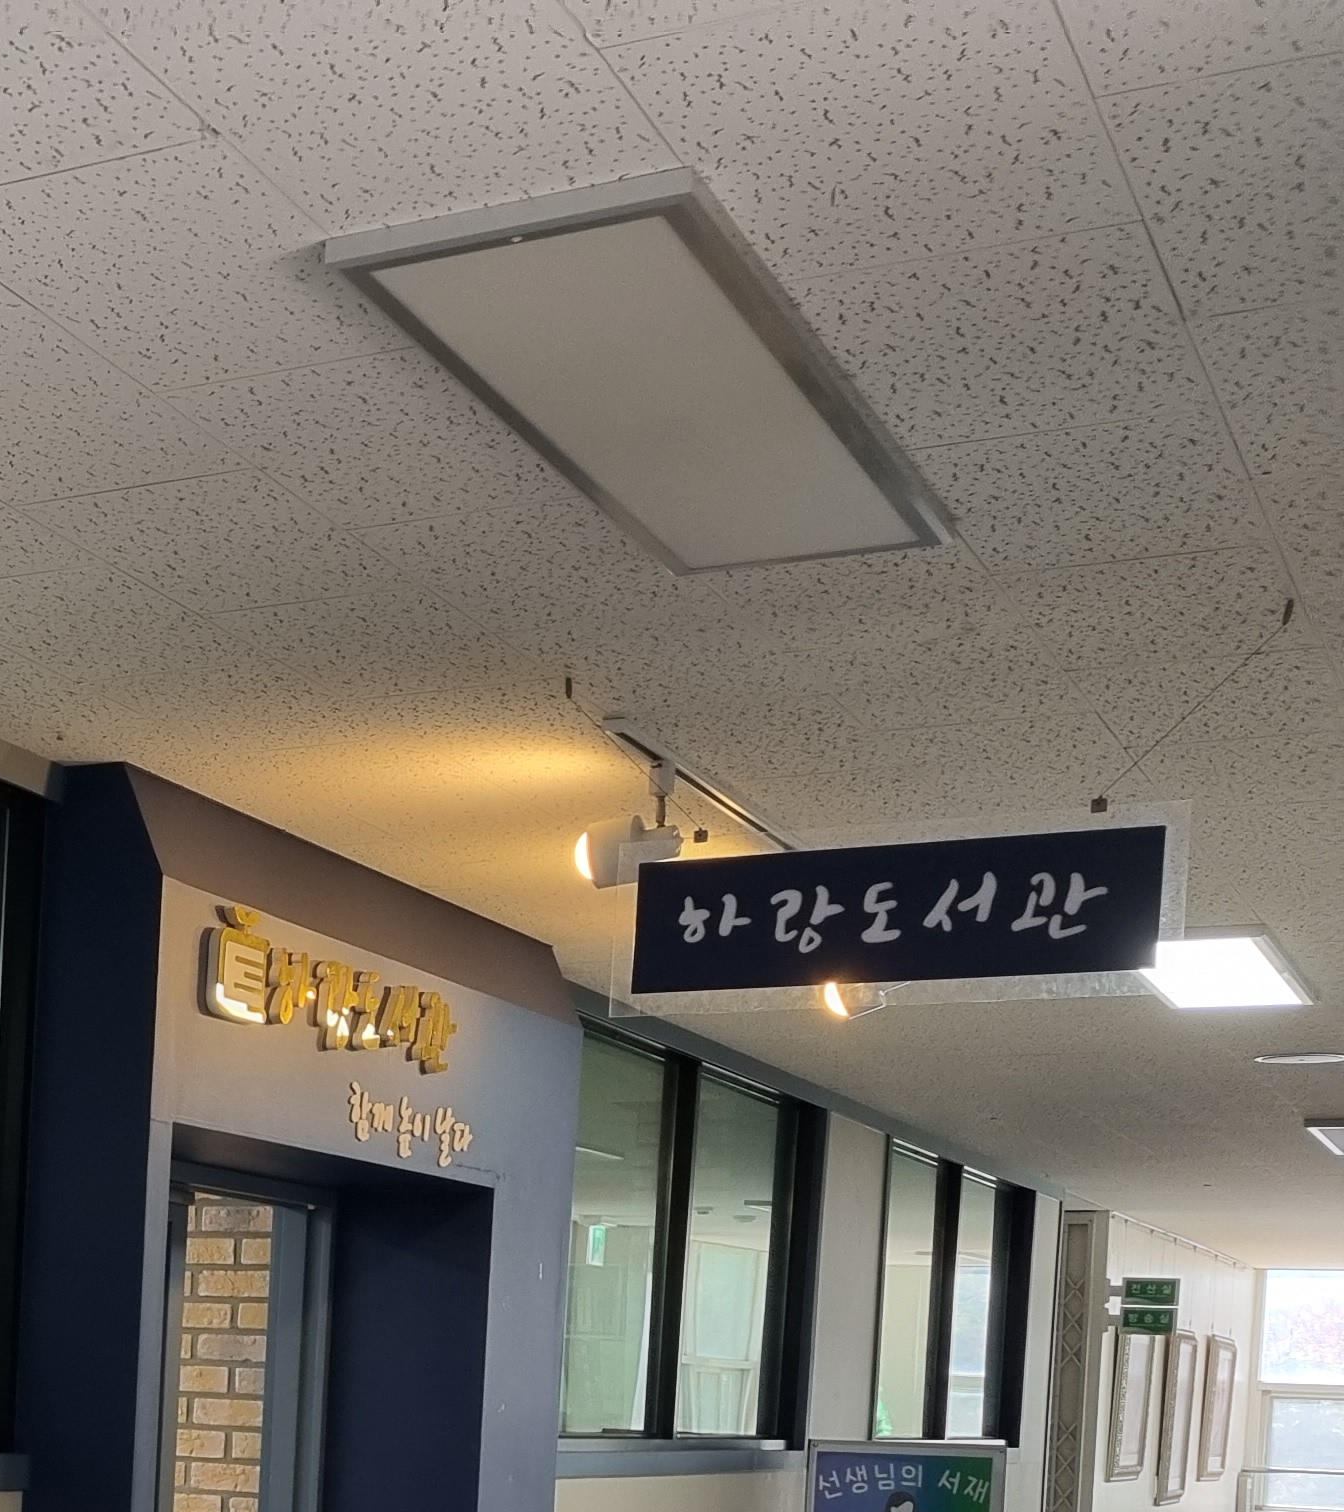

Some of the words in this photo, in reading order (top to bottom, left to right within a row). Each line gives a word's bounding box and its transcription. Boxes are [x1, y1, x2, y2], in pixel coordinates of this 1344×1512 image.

[678, 871, 1107, 953] 하랑도서관
[349, 1080, 394, 1142] 함께
[818, 1463, 923, 1499] 선생님의
[937, 1469, 990, 1503] 서재
